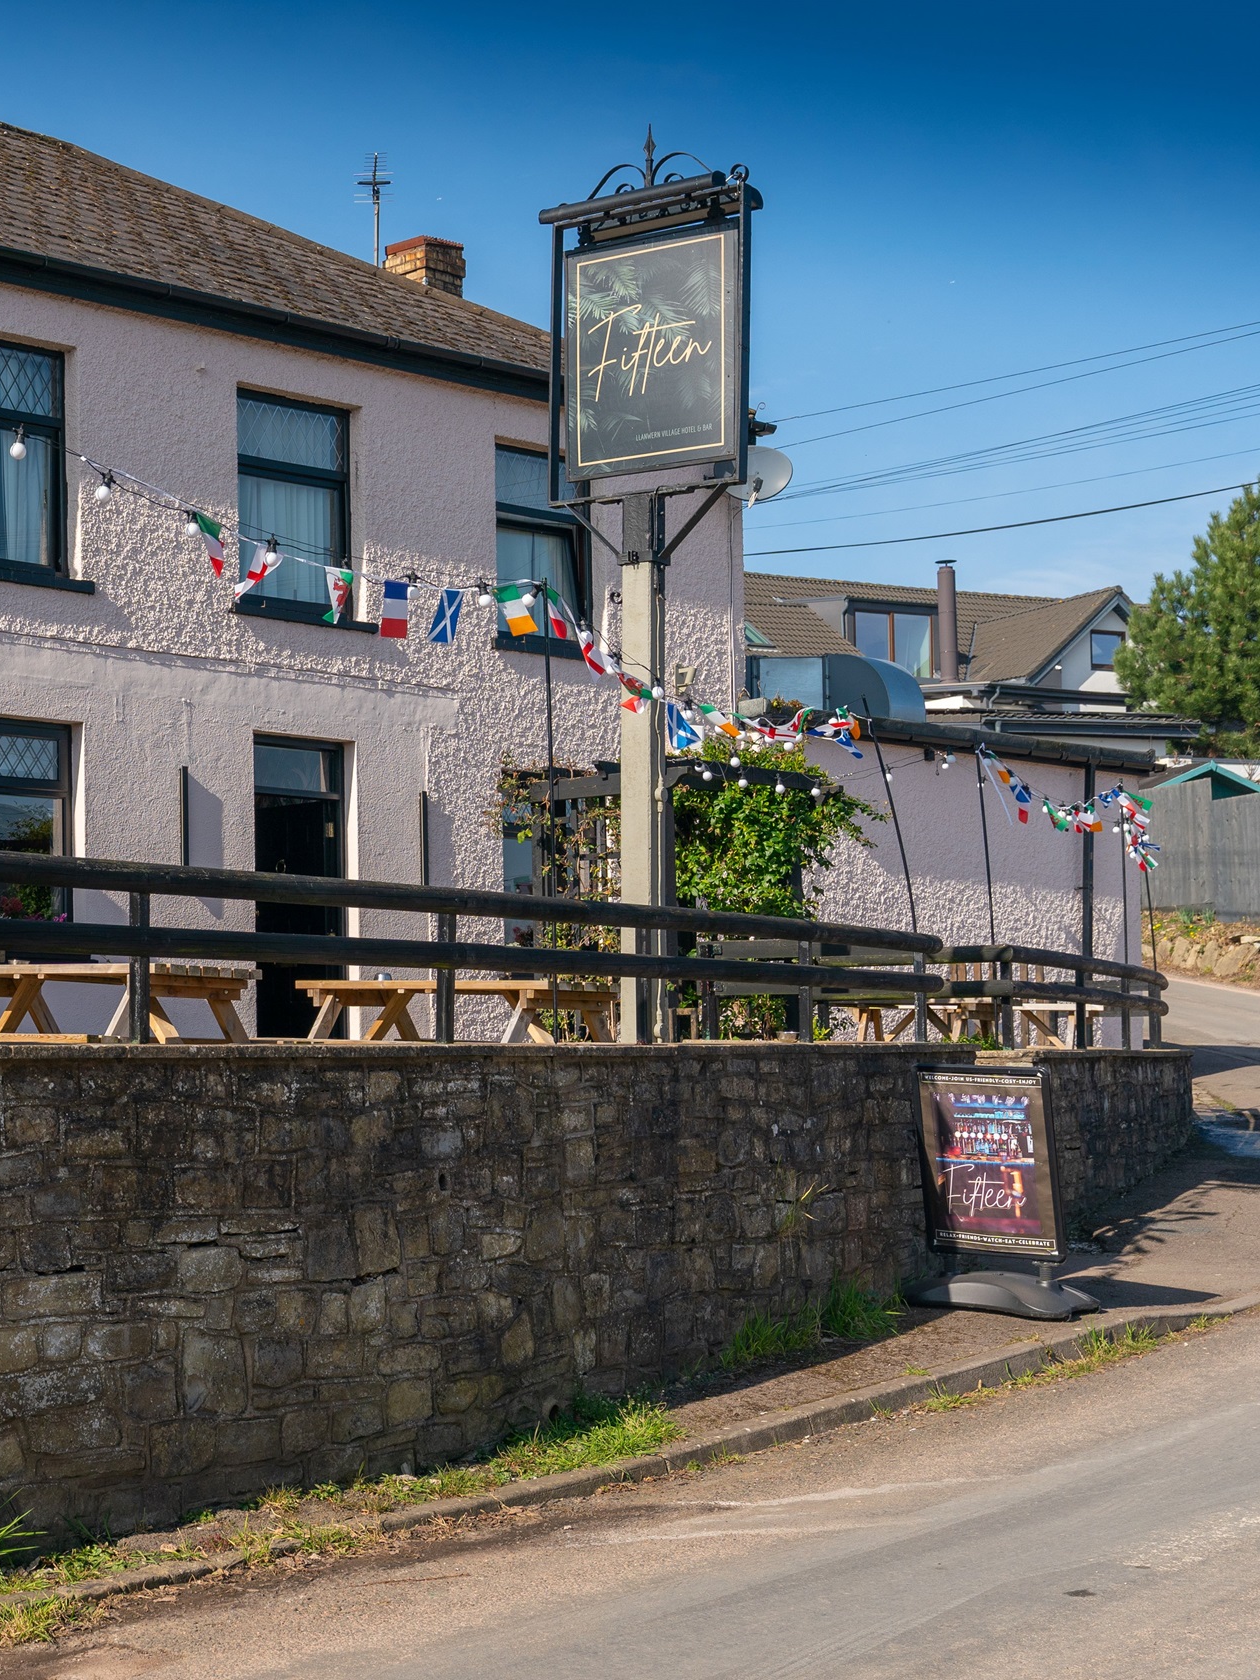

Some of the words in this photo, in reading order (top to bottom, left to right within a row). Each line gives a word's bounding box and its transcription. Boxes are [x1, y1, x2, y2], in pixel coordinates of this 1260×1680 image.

[588, 304, 712, 402] Fifteen
[635, 430, 661, 441] LLANWERN
[661, 427, 681, 437] VILLAGE
[681, 425, 696, 434] HOTEL
[702, 422, 713, 431] BAR
[942, 1163, 1027, 1217] Fifteen
